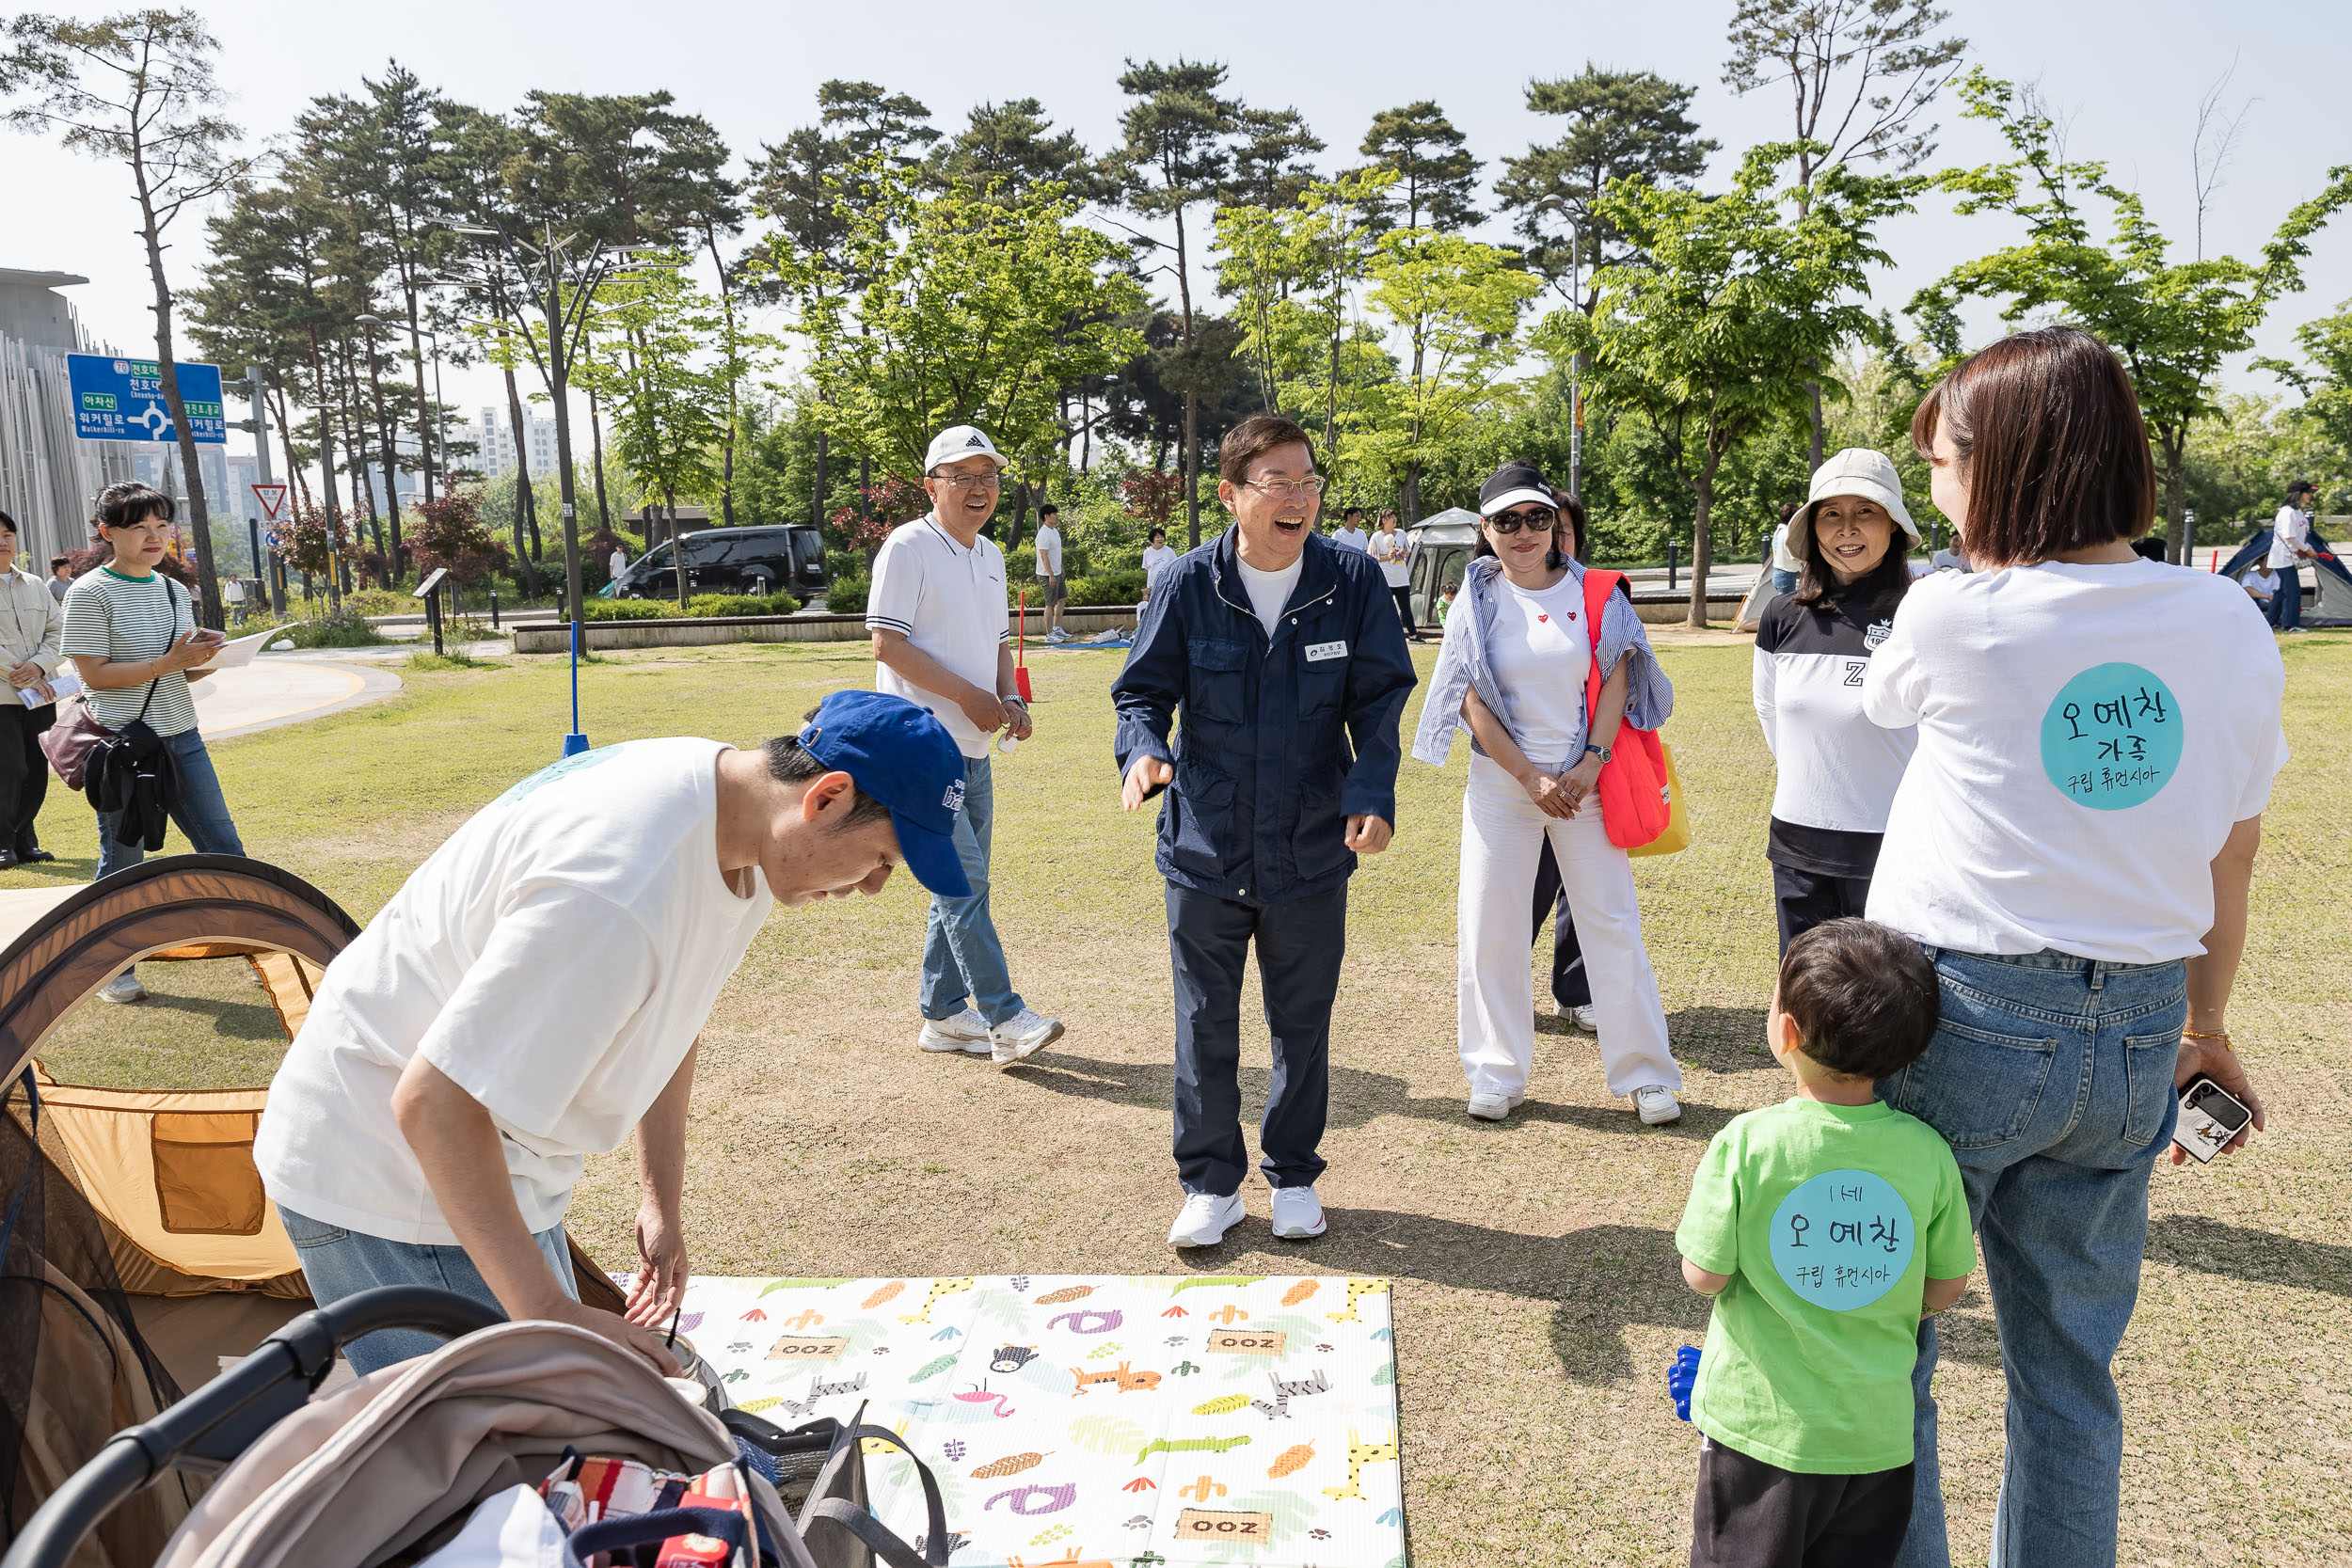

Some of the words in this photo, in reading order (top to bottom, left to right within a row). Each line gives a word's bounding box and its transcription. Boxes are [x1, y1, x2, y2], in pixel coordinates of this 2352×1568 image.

[116, 363, 127, 372] 70
[132, 364, 161, 375] 천호대
[85, 396, 115, 408] 아차산
[79, 412, 125, 427] 워커힐로
[1844, 661, 1867, 687] Z
[2062, 702, 2090, 741] 오
[2093, 686, 2168, 729] 예찬
[2097, 735, 2147, 762] 가족
[2068, 770, 2093, 795] 구립
[2101, 765, 2161, 792] 휴먼시아
[1789, 1213, 1810, 1248] 오
[1829, 1213, 1900, 1253] 예찬
[1795, 1265, 1825, 1289] 구립
[1834, 1263, 1891, 1289] 휴먼시아
[782, 1345, 836, 1354] ZOO
[1220, 1338, 1275, 1349] ZOO
[1192, 1520, 1258, 1534] ZOO
